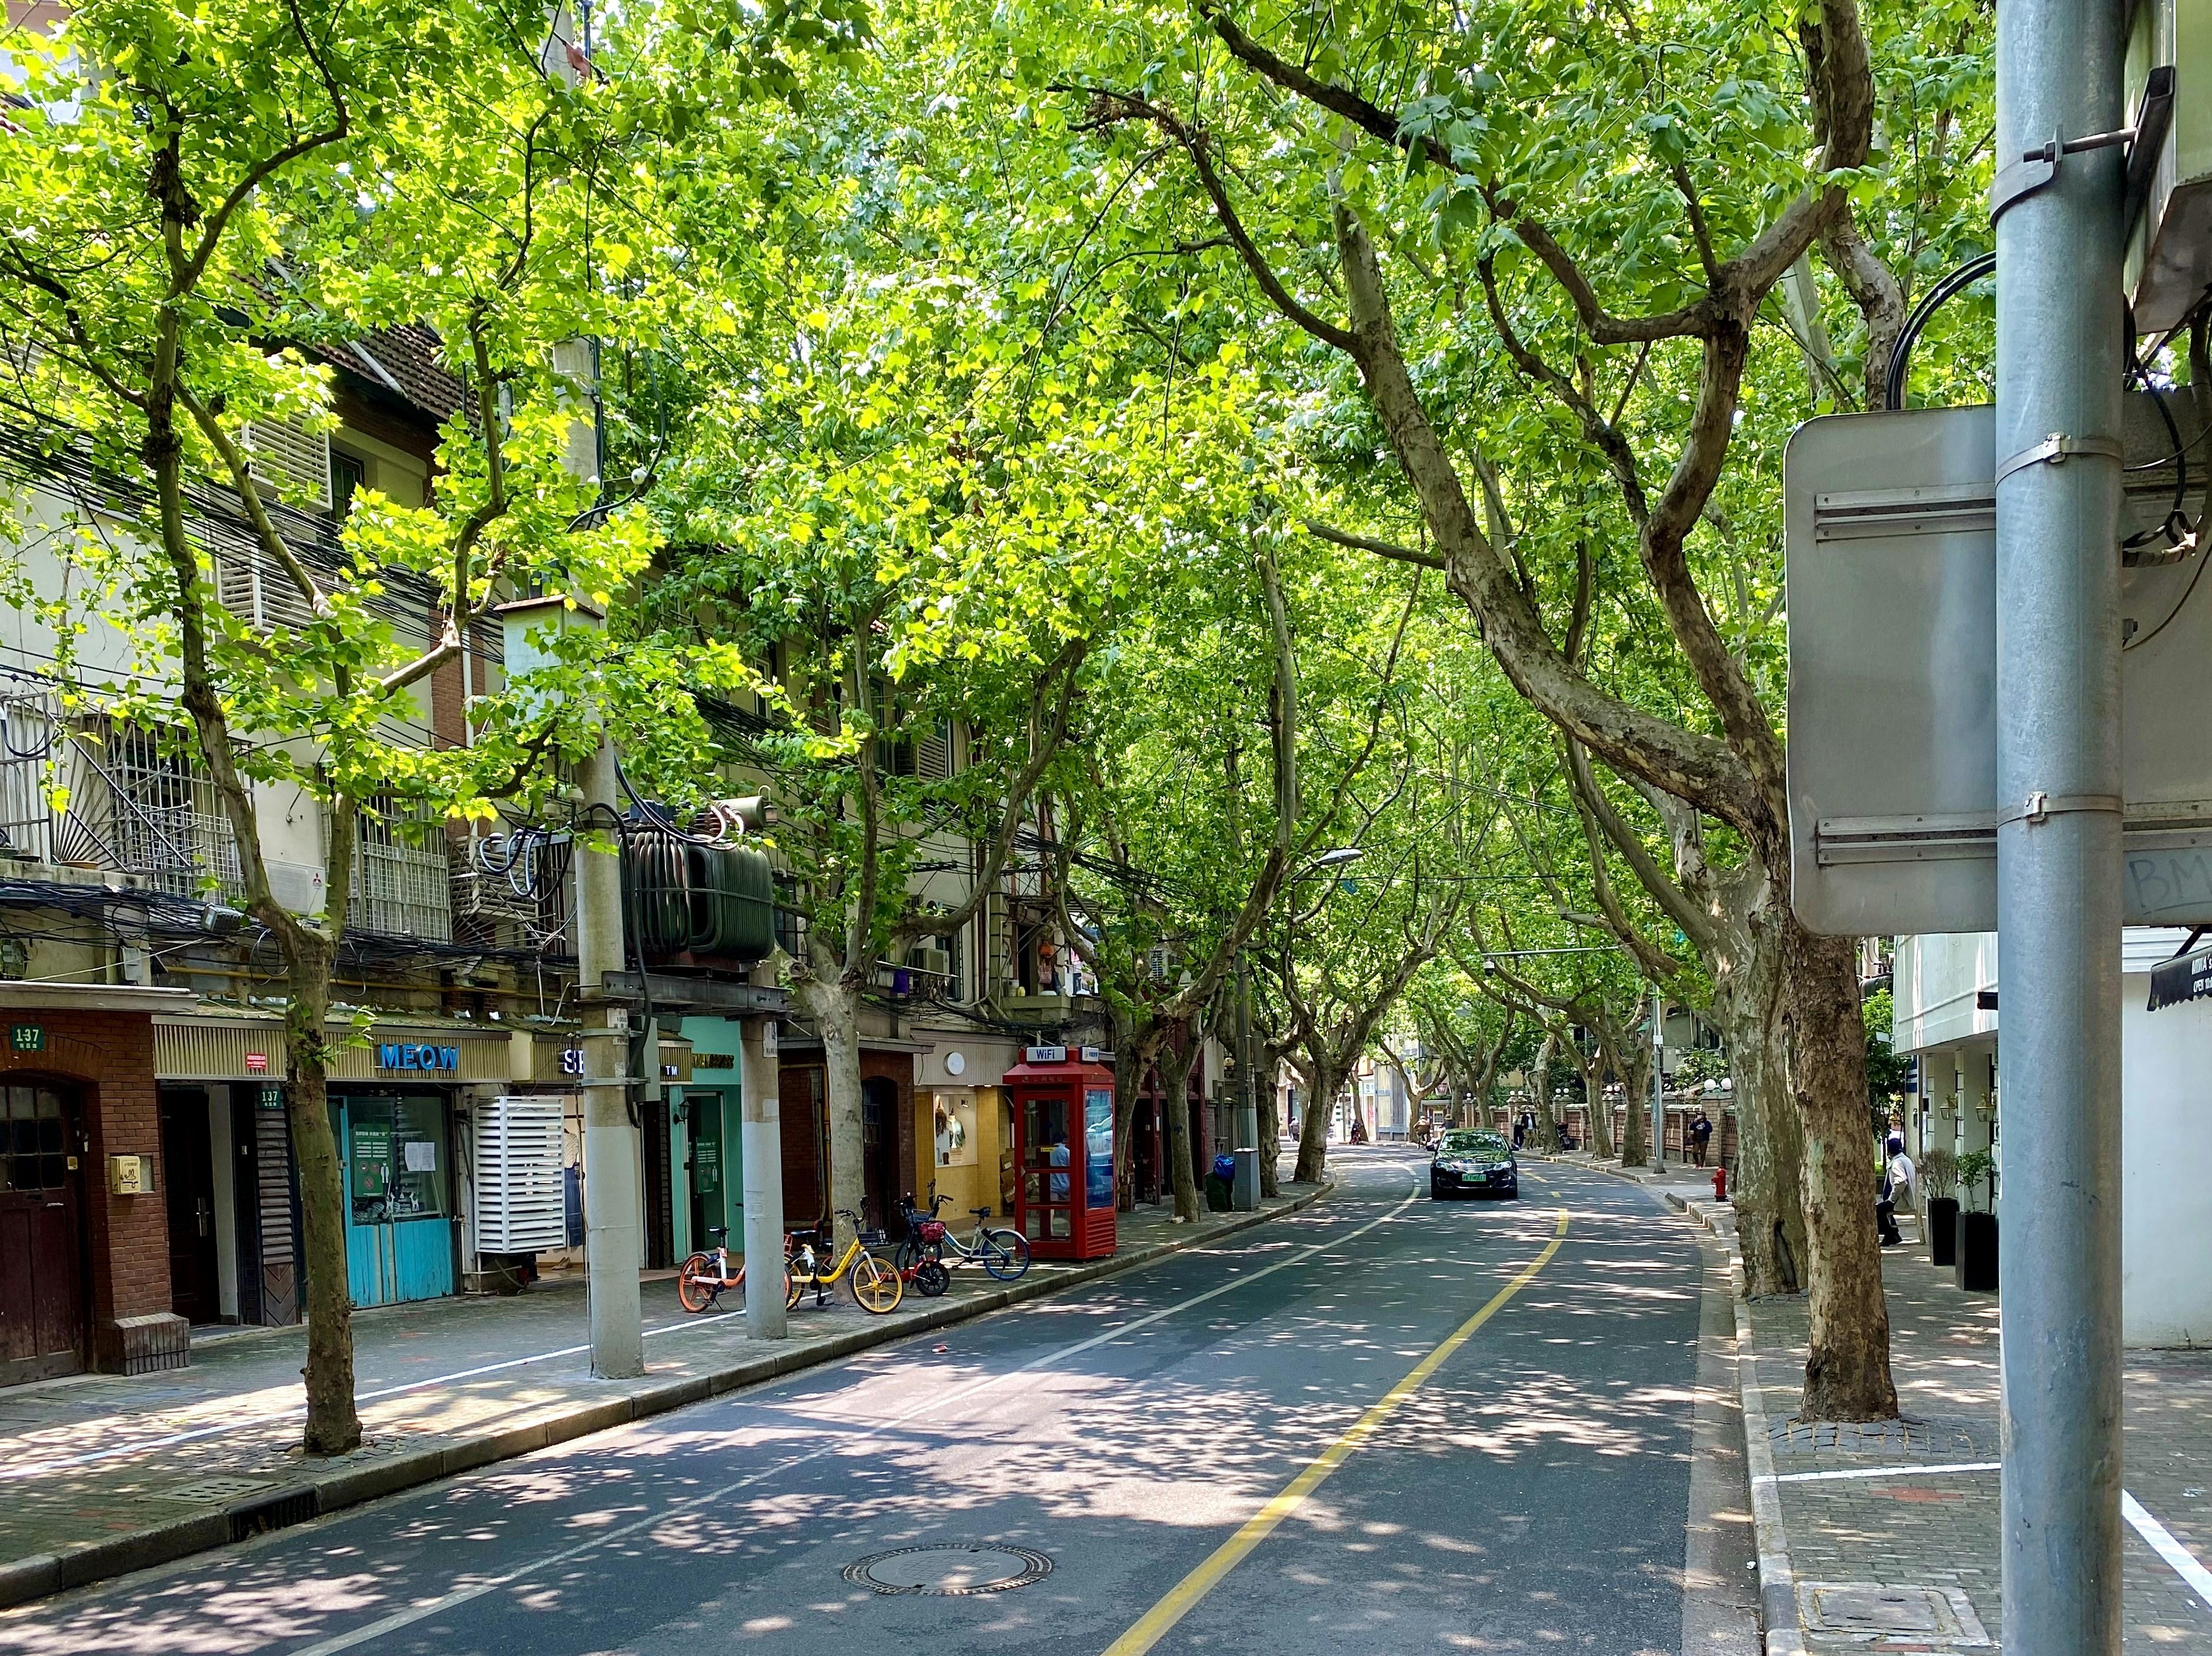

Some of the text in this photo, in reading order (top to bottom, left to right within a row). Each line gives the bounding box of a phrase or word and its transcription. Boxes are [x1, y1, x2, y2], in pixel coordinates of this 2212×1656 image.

[16, 1029, 39, 1041] 137
[381, 1044, 460, 1069] MEOW
[1036, 1049, 1055, 1059] WiFi
[665, 1065, 677, 1075] TM
[262, 1091, 278, 1101] 137
